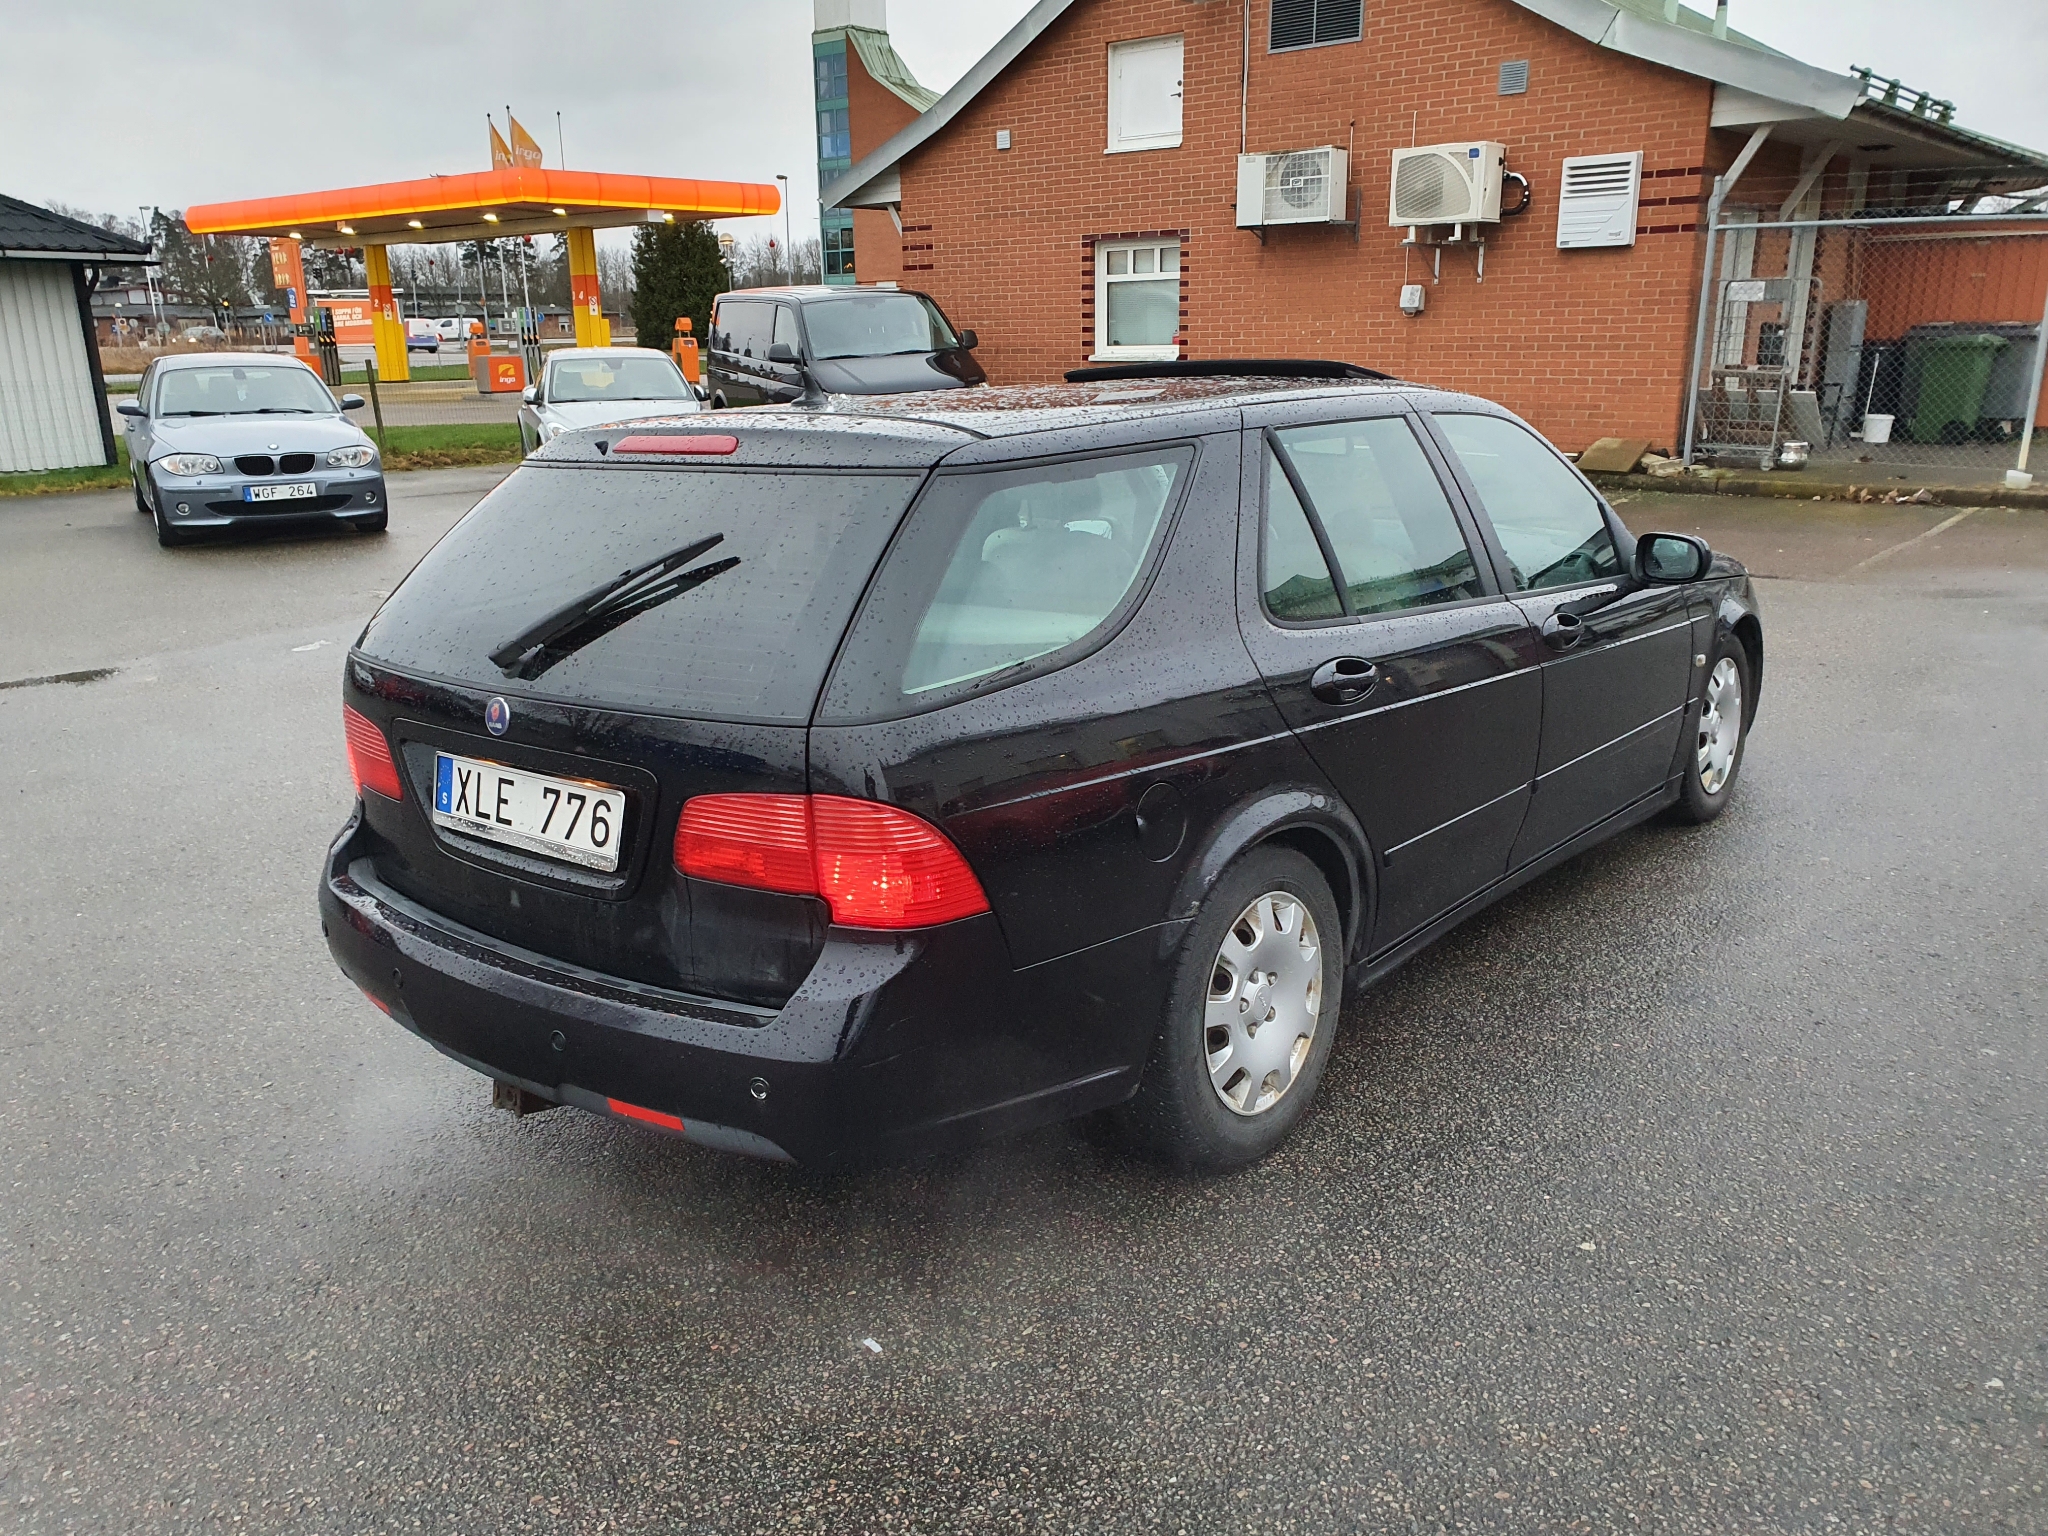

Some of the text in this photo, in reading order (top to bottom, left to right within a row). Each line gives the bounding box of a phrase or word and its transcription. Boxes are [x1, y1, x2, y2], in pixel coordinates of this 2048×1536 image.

[515, 145, 542, 160] ingo
[578, 290, 584, 300] 4
[374, 298, 379, 307] 2
[499, 376, 516, 384] ingo
[253, 487, 277, 499] WGF
[288, 485, 313, 497] 264
[442, 767, 611, 847] S XLE 776
